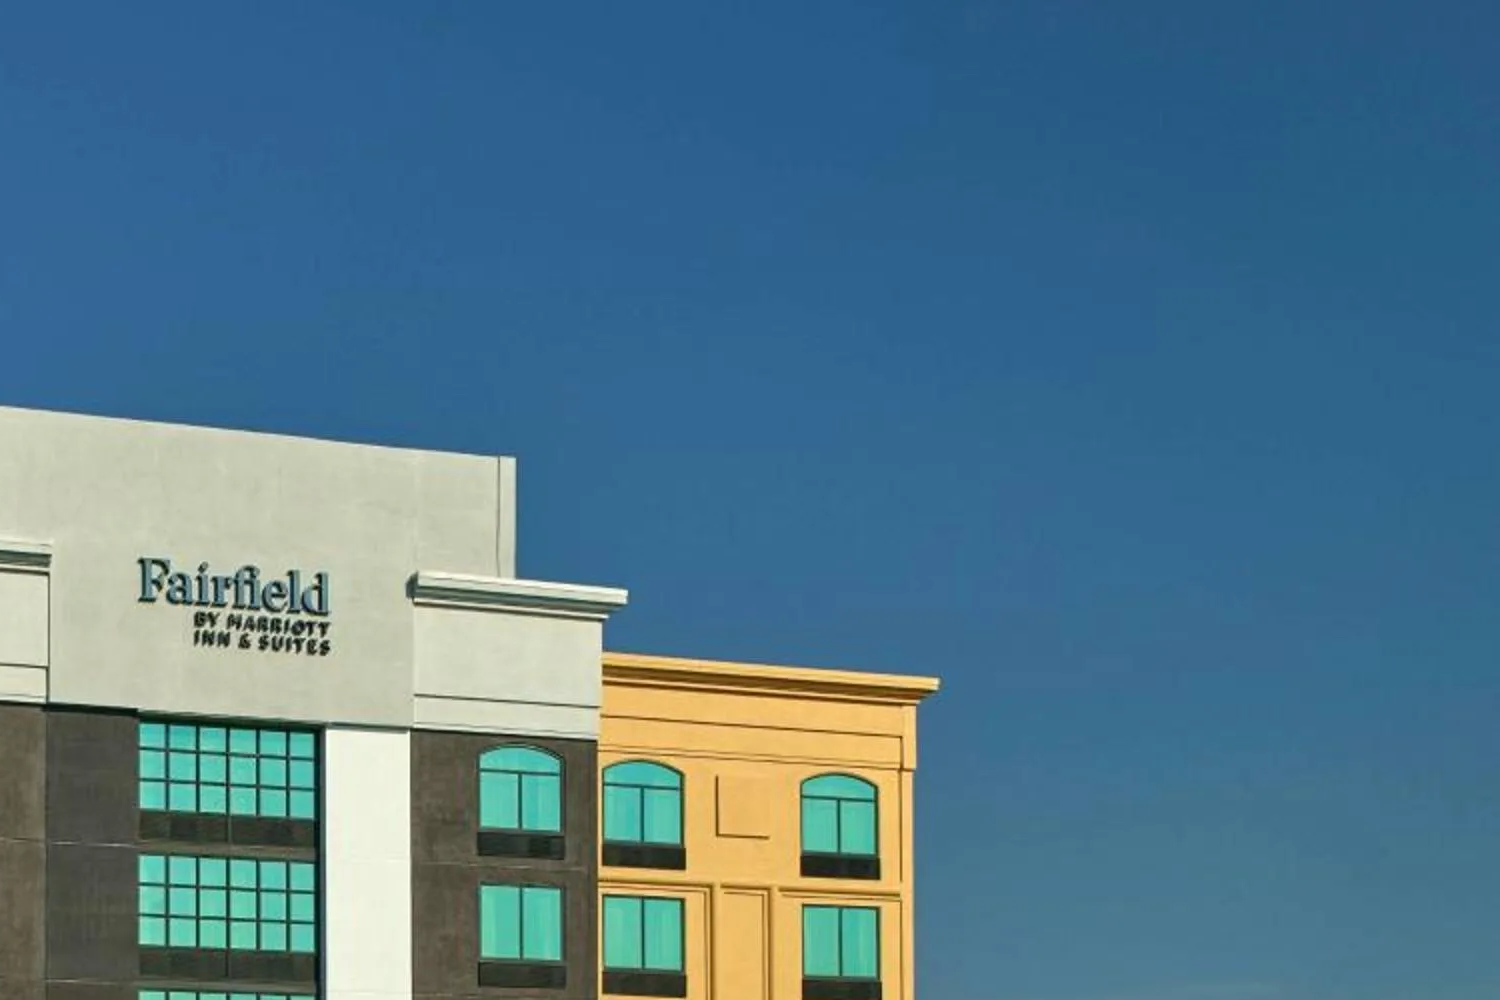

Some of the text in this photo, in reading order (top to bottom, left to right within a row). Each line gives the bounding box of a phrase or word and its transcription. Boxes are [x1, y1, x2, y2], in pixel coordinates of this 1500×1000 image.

[137, 557, 330, 616] Fairfield
[193, 611, 332, 638] BY MARRIOTT
[193, 630, 332, 657] INN & SUITES
